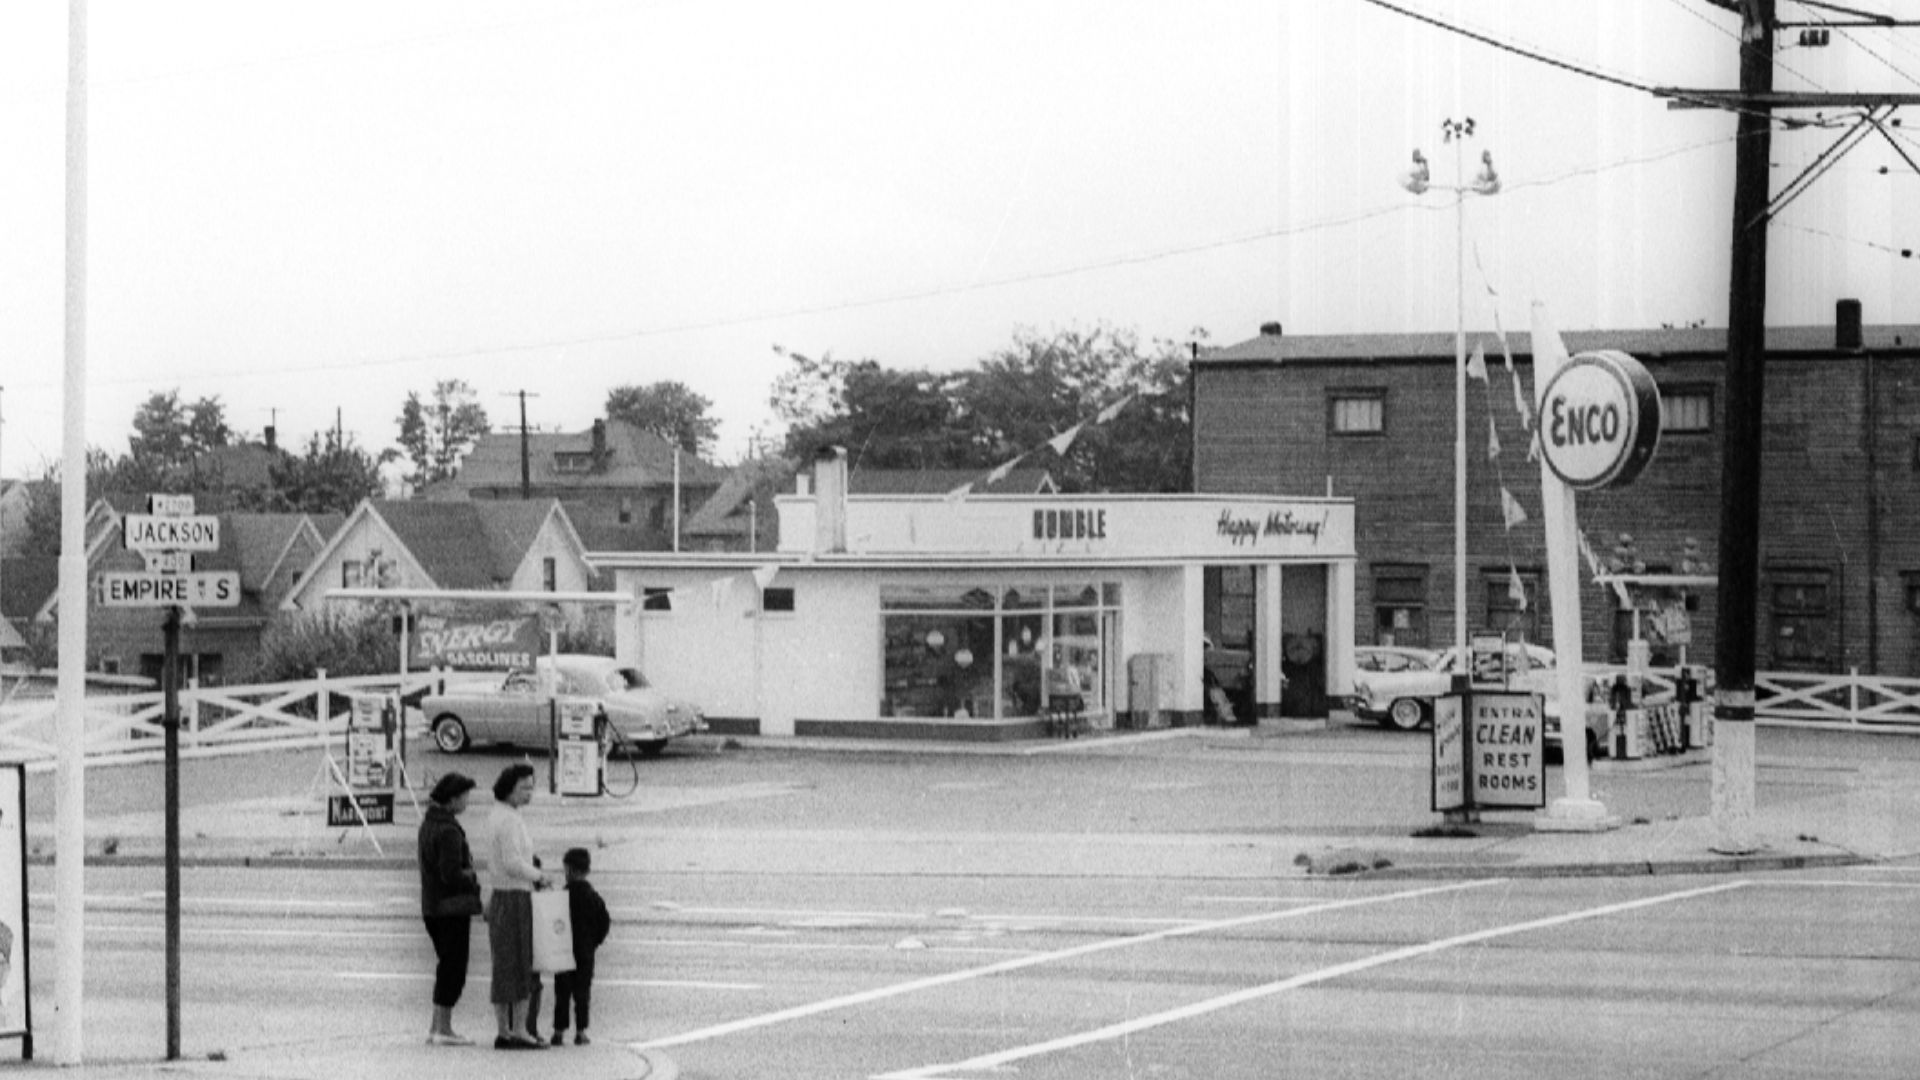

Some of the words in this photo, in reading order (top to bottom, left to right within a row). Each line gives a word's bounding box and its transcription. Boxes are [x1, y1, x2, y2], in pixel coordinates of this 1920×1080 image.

[1551, 397, 1620, 448] ENCO
[133, 521, 214, 543] JACKSON
[1217, 508, 1261, 546] Happy
[110, 578, 188, 601] EMPIRE
[216, 578, 230, 601] S
[446, 651, 531, 667] GASOLINES
[1479, 706, 1535, 719] EXTRA
[1476, 724, 1536, 745] CLEAN
[1483, 753, 1532, 768] REST
[1479, 774, 1538, 791] ROOMS
